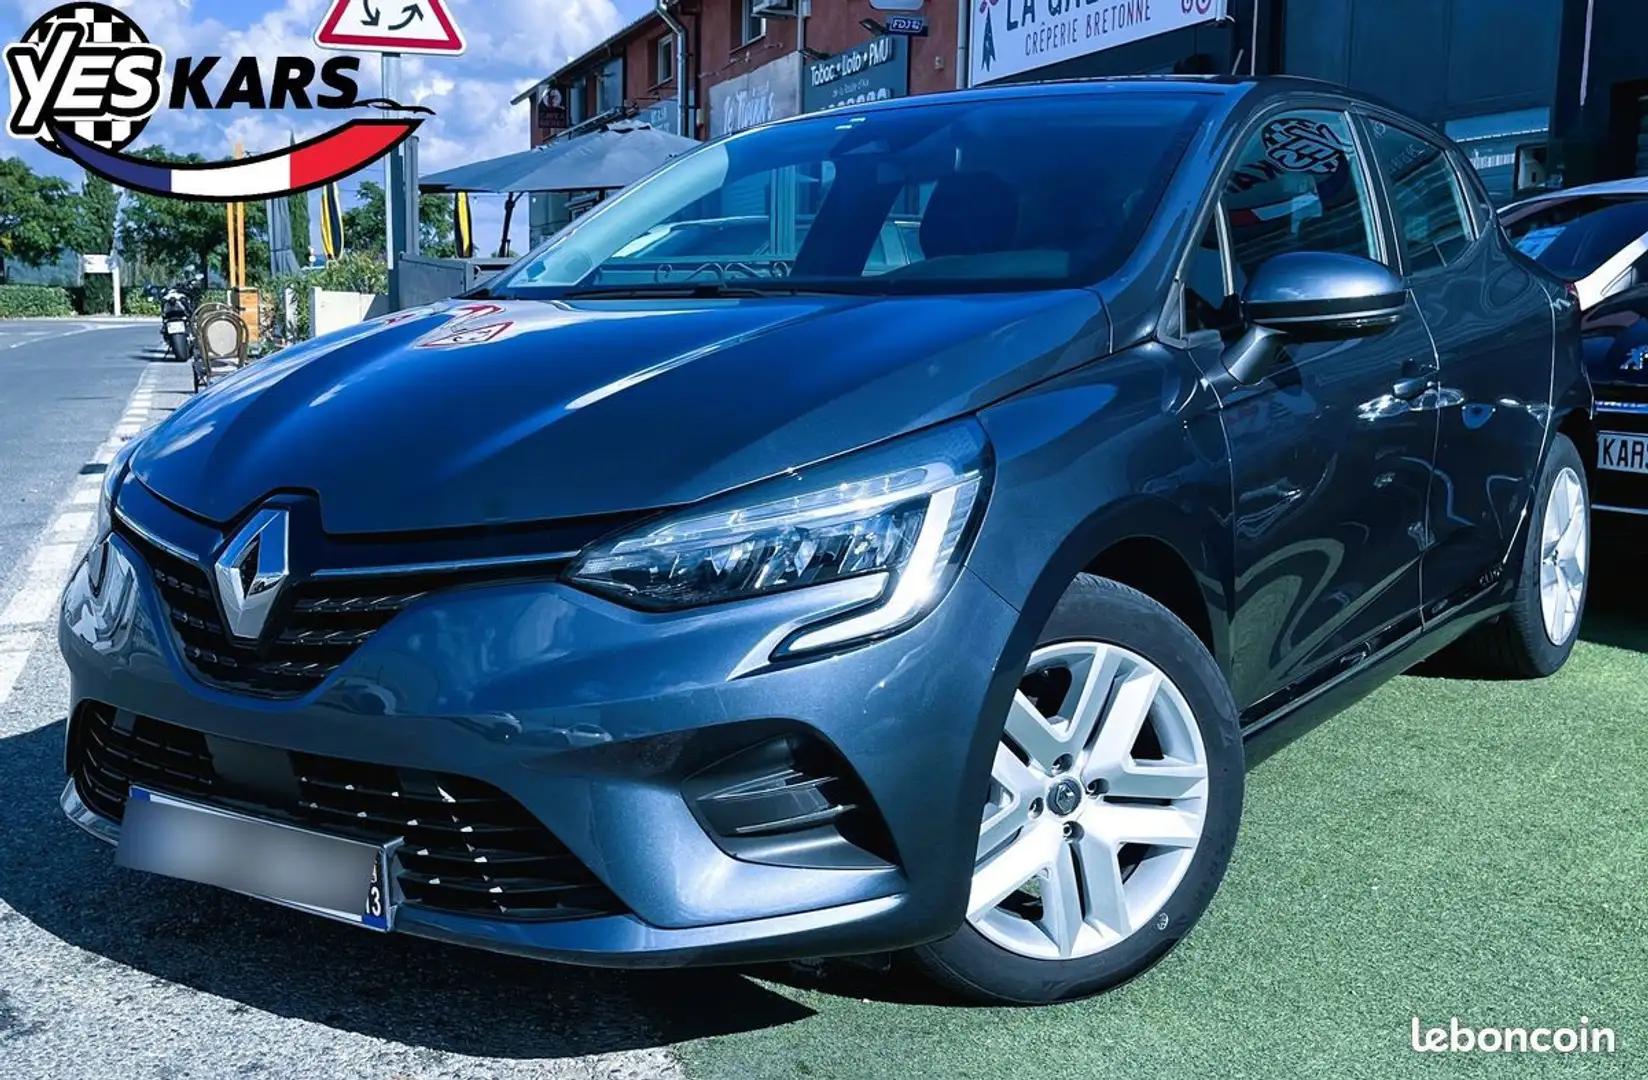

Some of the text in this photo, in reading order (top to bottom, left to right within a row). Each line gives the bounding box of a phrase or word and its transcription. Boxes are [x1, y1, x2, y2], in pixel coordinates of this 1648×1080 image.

[1025, 19, 1078, 56] CRÊPERIE
[1085, 3, 1151, 39] BRETONNE
[842, 51, 861, 77] Loto
[869, 37, 889, 67] PMU
[1603, 438, 1648, 469] KAR
